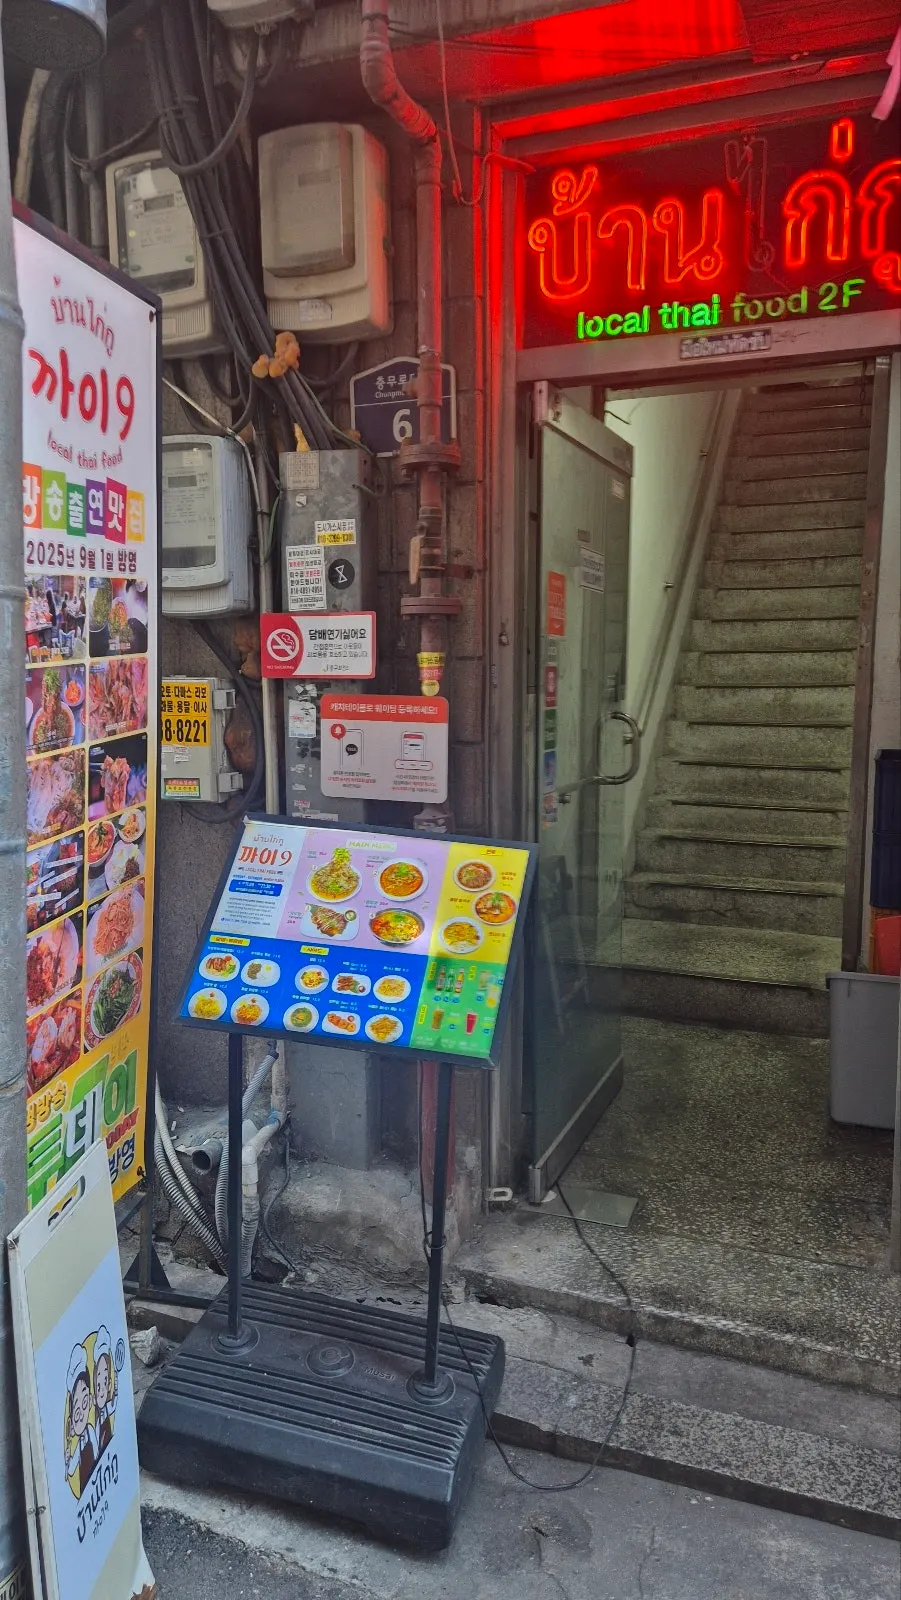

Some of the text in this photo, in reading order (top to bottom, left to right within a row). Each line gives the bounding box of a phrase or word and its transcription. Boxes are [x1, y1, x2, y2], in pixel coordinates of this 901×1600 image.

[577, 278, 867, 340] local thai food 2F
[393, 409, 413, 443] 6
[48, 427, 123, 470] local thai food
[26, 540, 75, 568] 2025년
[79, 547, 96, 570] 9월
[100, 548, 114, 571] 1일
[308, 628, 368, 641] 담배연기싫어요
